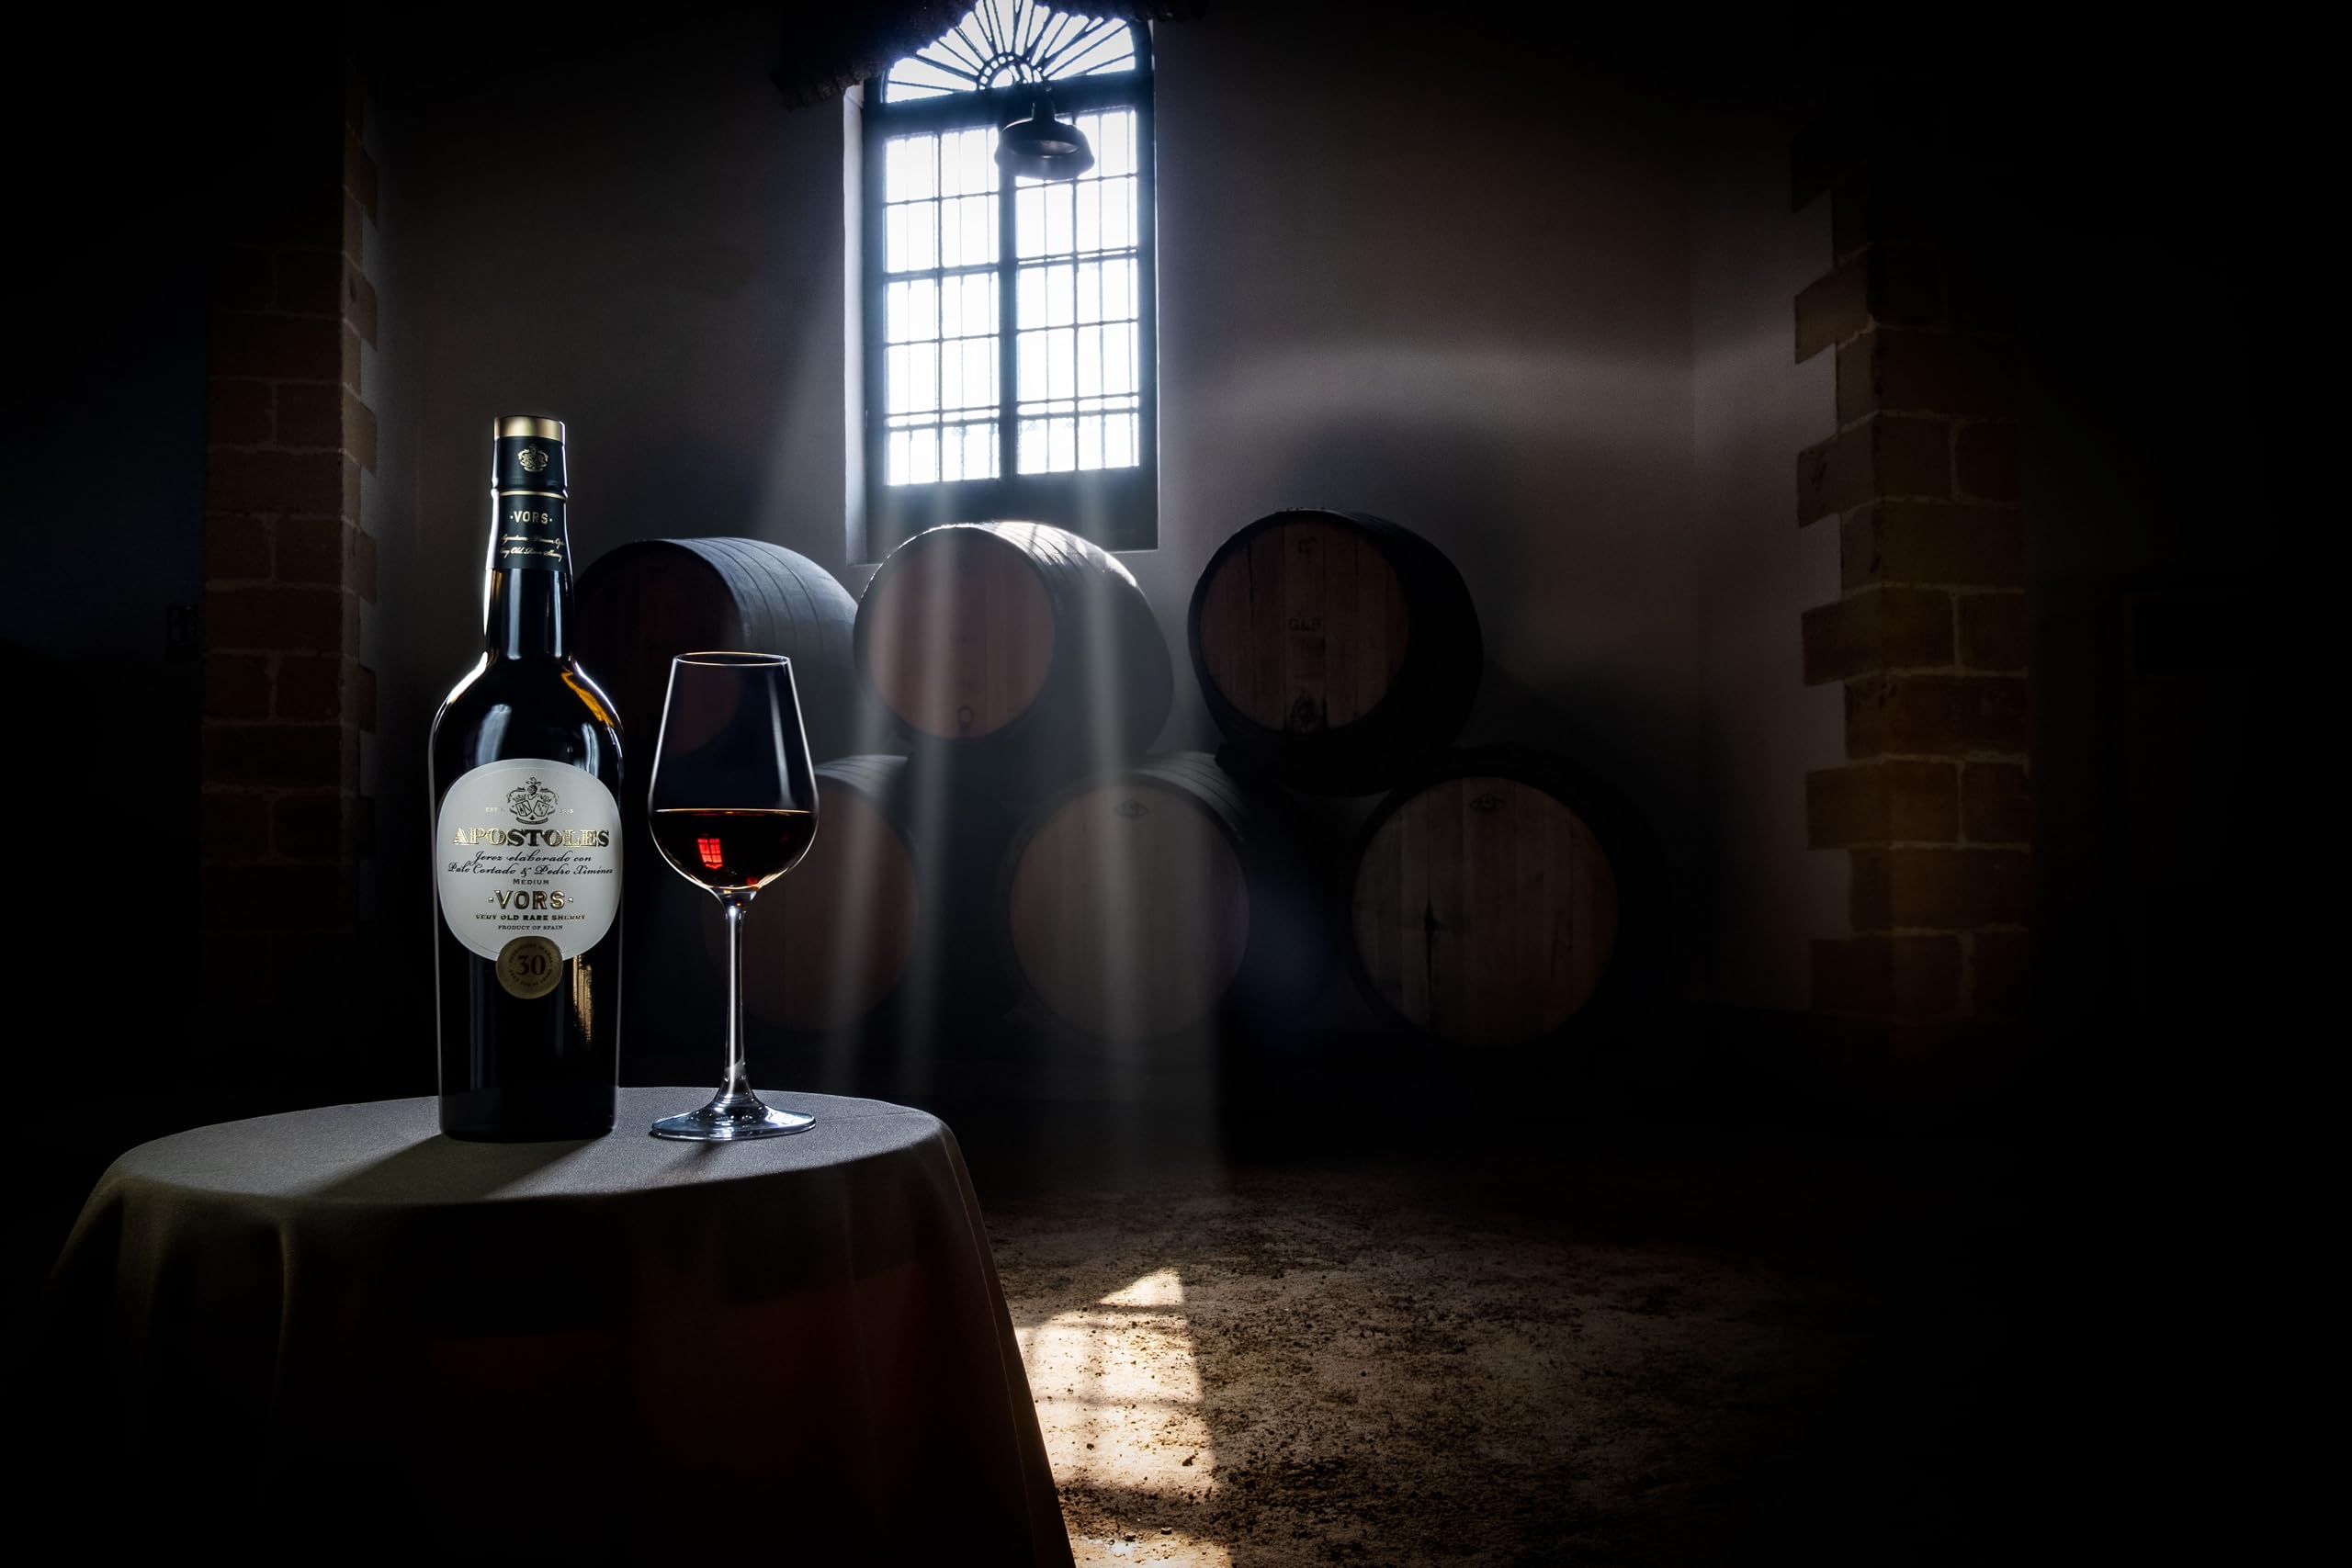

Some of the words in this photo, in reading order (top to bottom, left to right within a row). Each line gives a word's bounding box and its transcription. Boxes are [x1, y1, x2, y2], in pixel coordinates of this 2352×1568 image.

[452, 827, 610, 848] APOSTOLES
[469, 850, 503, 867] Jerez
[505, 850, 573, 863] elaborado
[447, 860, 470, 874] Palo
[472, 862, 520, 874] Cortado
[520, 866, 532, 878] &
[534, 863, 571, 875] Pedro
[515, 954, 546, 976] 30
